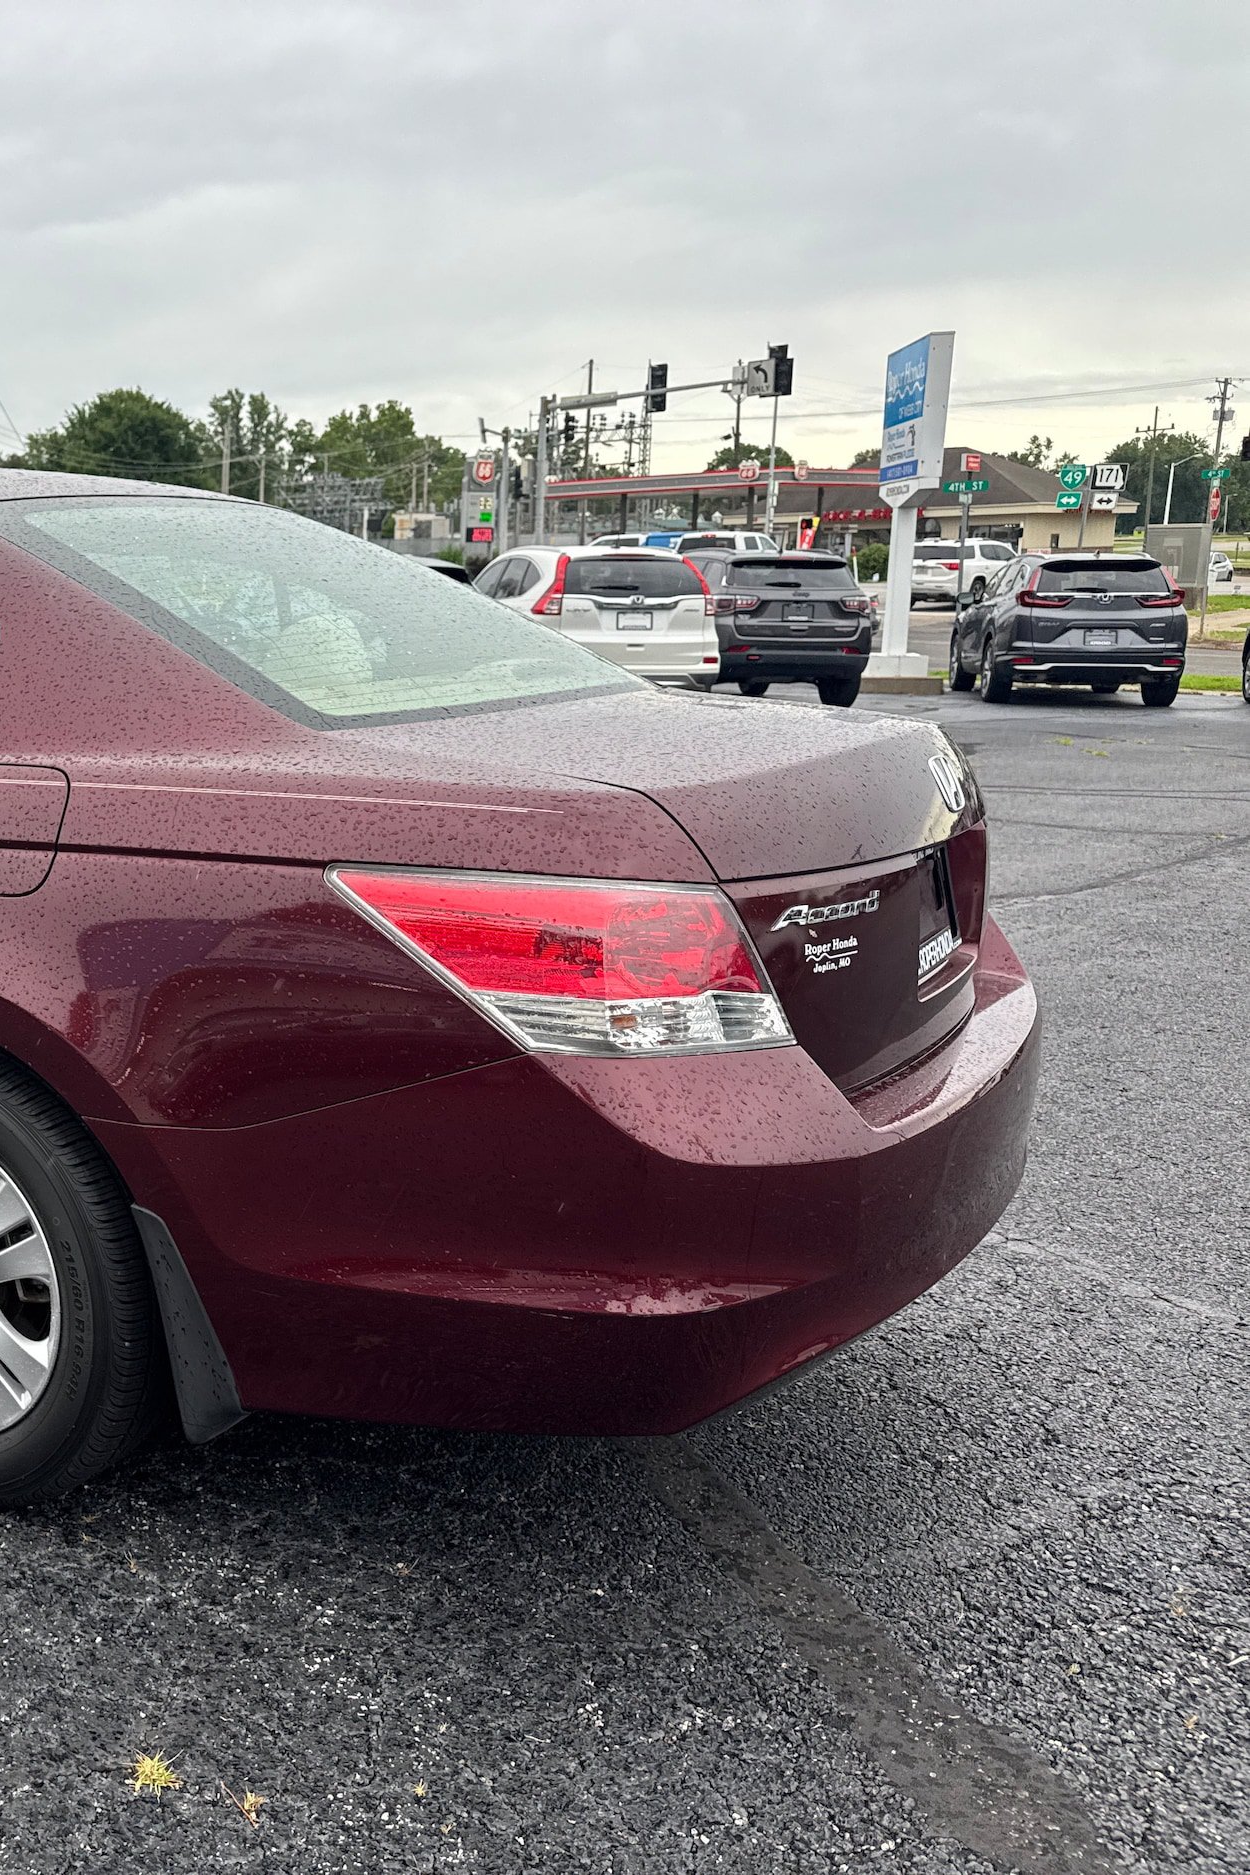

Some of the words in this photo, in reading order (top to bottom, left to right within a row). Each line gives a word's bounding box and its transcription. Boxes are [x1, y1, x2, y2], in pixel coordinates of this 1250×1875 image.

[750, 384, 771, 393] ONLY
[478, 462, 492, 477] 66
[741, 469, 754, 478] 66
[1099, 468, 1120, 483] 171
[1063, 471, 1082, 484] 49
[948, 482, 966, 492] 4TH
[972, 481, 984, 491] ST
[770, 889, 881, 932] Accord
[804, 942, 831, 956] Roper
[831, 935, 858, 951] Honda
[813, 961, 838, 974] Joplin,
[838, 957, 851, 969] MO
[58, 1239, 85, 1312] 215/60
[73, 1315, 87, 1359] R16
